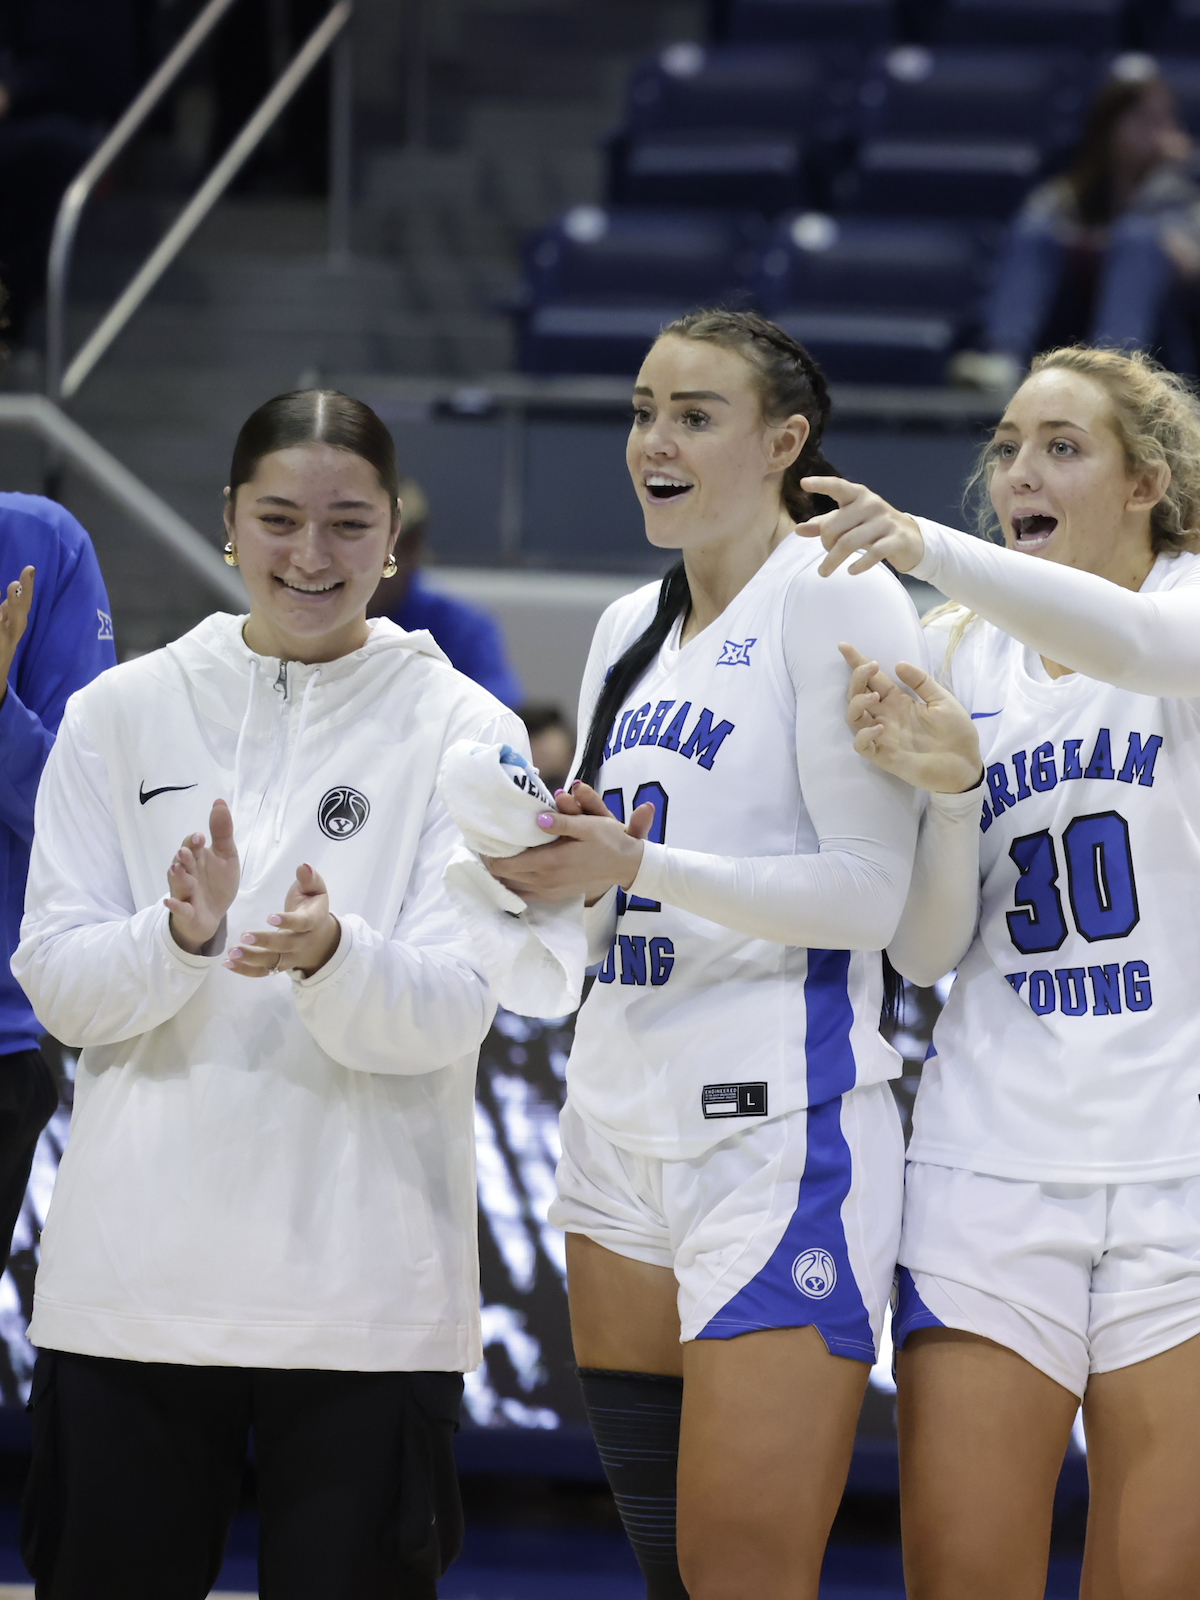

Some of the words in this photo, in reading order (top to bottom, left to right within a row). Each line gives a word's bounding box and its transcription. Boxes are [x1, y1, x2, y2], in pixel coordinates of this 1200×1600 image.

[600, 700, 735, 771] IGHAM
[1006, 810, 1140, 955] 30
[598, 934, 675, 986] UNG
[746, 1092, 756, 1106] L
